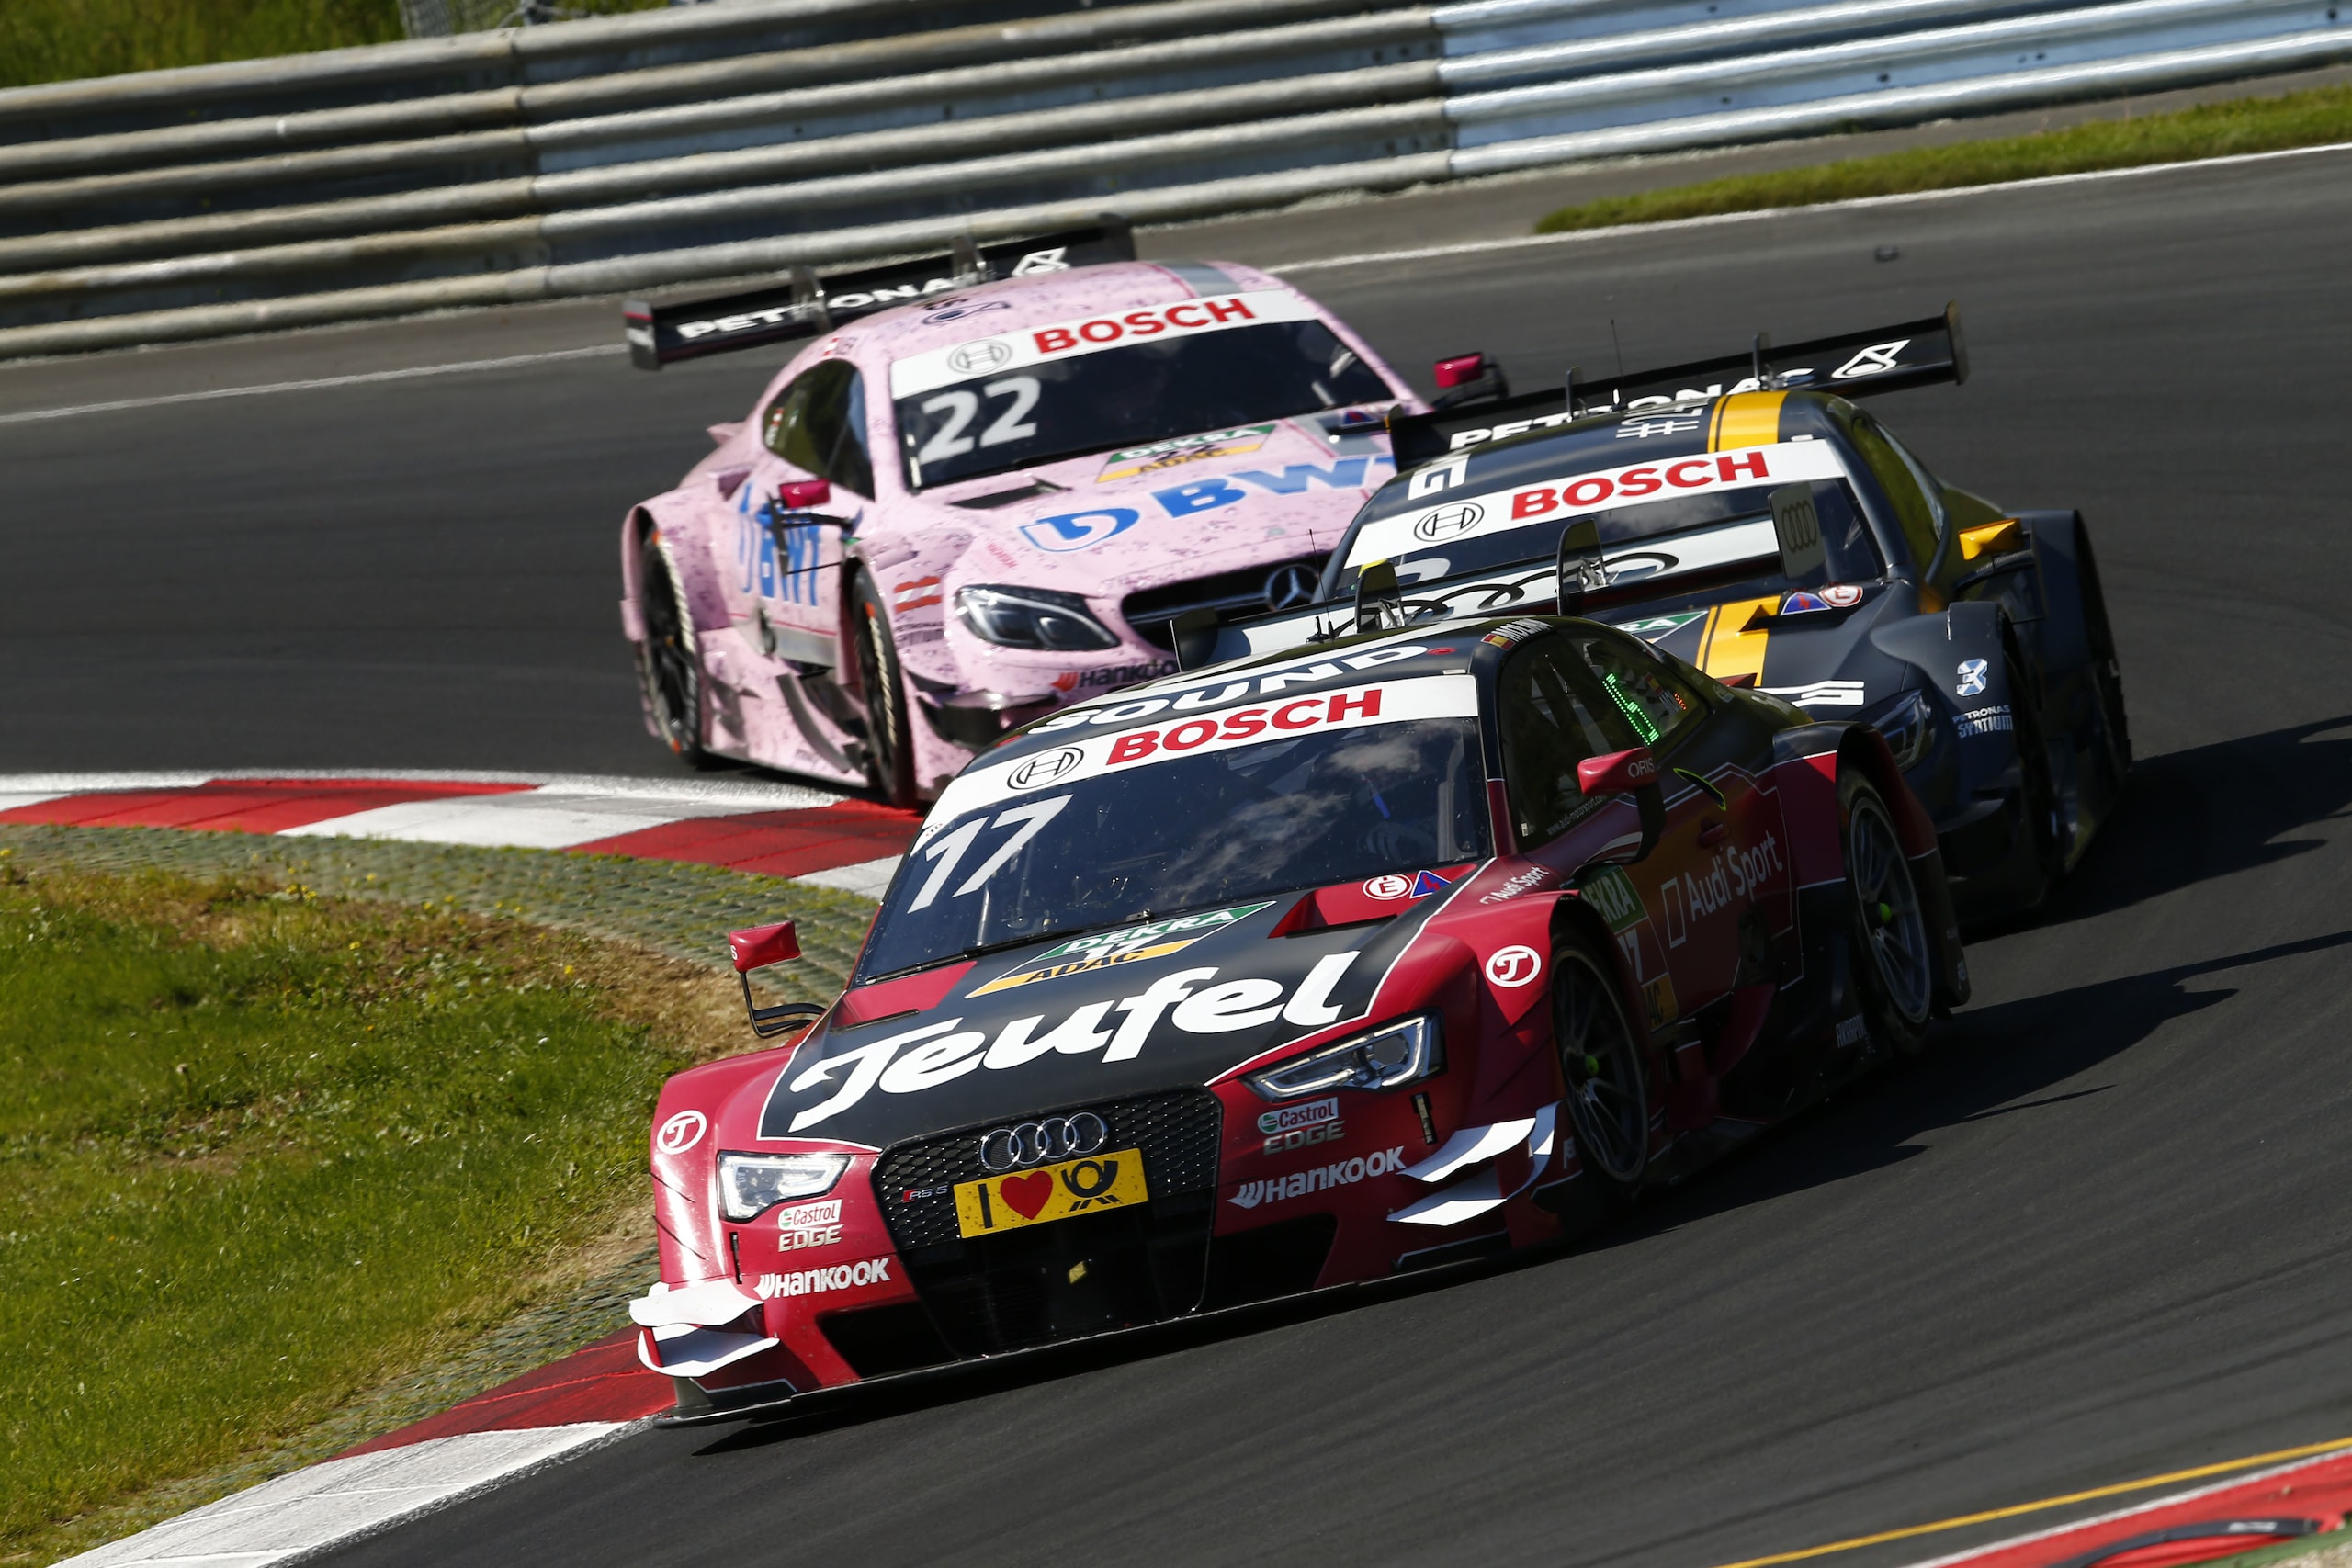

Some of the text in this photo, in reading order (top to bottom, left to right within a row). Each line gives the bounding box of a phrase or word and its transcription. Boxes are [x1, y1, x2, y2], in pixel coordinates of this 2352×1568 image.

[676, 271, 985, 339] PETONA
[1033, 299, 1256, 353] BOSCH
[917, 376, 1040, 465] 22
[1120, 428, 1261, 459] DEKRA
[1510, 442, 1770, 521] BOSCH
[1026, 645, 1430, 735] SOUND
[1955, 658, 1988, 698] 3
[1105, 688, 1383, 766] BOSCH
[1952, 705, 2011, 725] PETRONAS
[1957, 715, 2014, 739] SYNTIUM
[1627, 757, 1655, 779] ORIS
[1545, 795, 1607, 836] www.audi-motorsport.co
[906, 793, 1074, 915] 17
[1490, 865, 1550, 900] Audi Sport
[1684, 829, 1783, 923] Audi Sport
[1062, 909, 1236, 954] DEKRA
[1083, 933, 1167, 962] 17
[1025, 949, 1146, 983] ADAC
[786, 950, 1361, 1134] Teufel
[1278, 1101, 1334, 1128] Castrol
[1263, 1120, 1346, 1156] EDGE
[793, 1203, 836, 1226] Castrol
[978, 1183, 993, 1229] I
[777, 1224, 844, 1253] EDGE
